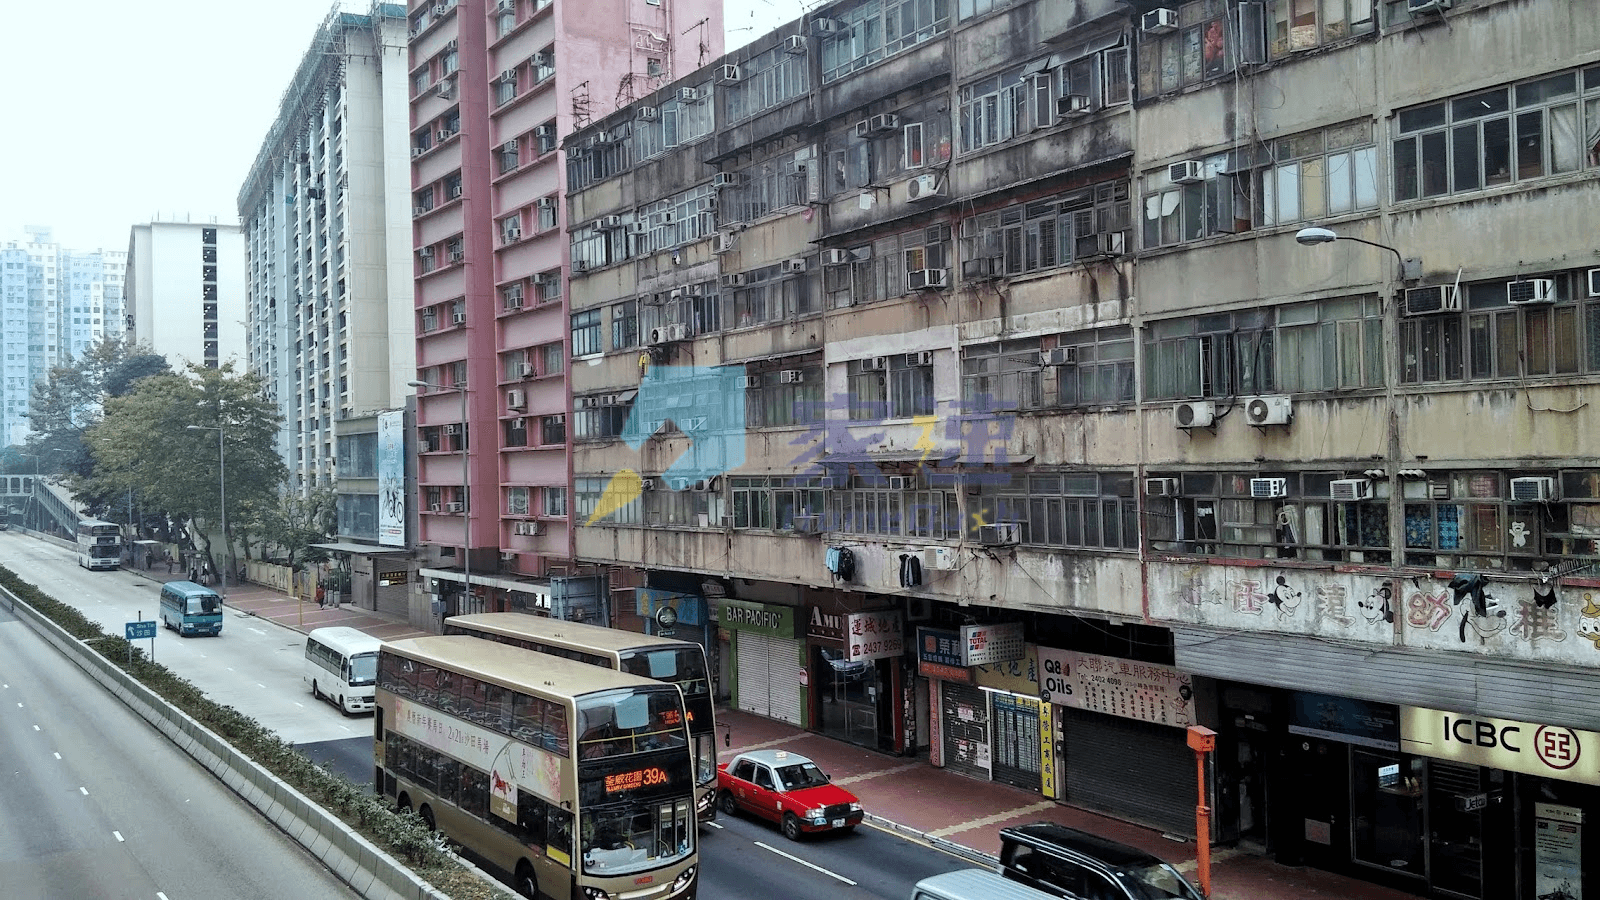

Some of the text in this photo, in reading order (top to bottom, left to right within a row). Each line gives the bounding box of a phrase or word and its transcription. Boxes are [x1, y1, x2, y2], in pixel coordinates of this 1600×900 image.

[726, 606, 778, 629] BAR PACIFIC
[136, 629, 150, 637] 沙田
[969, 636, 988, 645] TOTAL
[863, 642, 881, 655] 2437
[1044, 659, 1061, 675] Q8
[1078, 657, 1191, 685] 大聯汽車服務中心
[1046, 677, 1073, 695] Oils
[1091, 674, 1106, 684] 2402
[1107, 677, 1122, 686] 4098
[1443, 716, 1521, 753] ICBC
[643, 767, 667, 785] 39A
